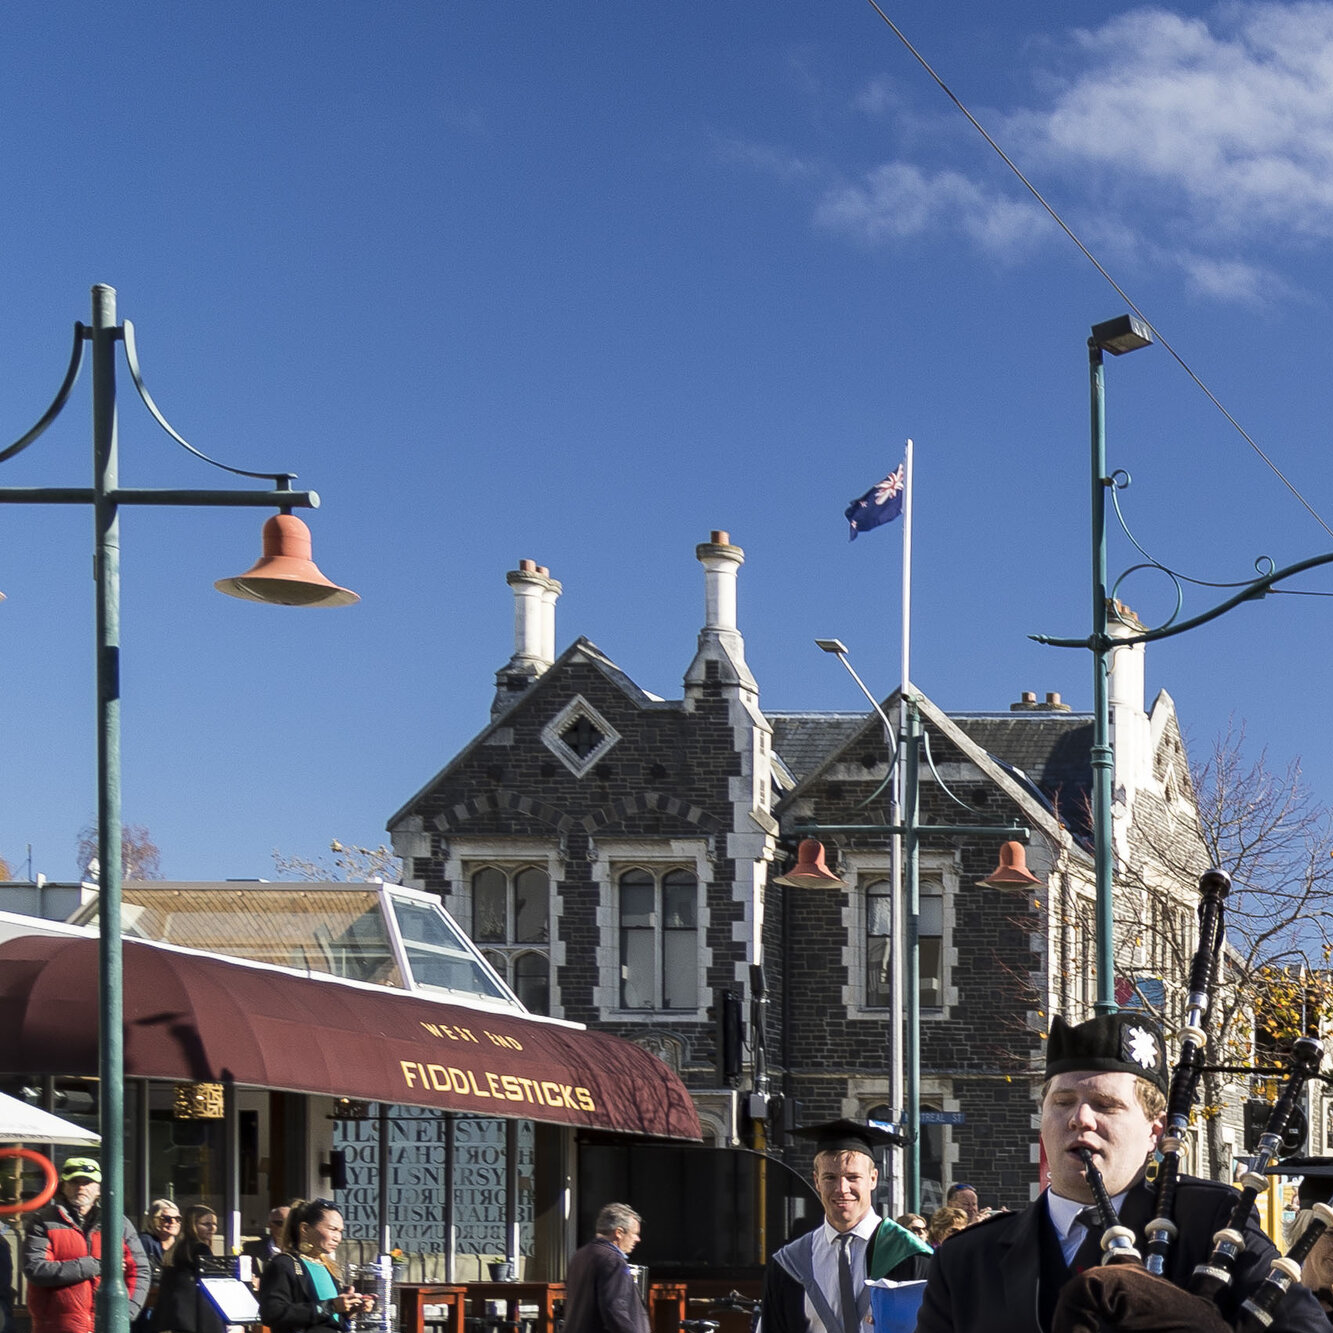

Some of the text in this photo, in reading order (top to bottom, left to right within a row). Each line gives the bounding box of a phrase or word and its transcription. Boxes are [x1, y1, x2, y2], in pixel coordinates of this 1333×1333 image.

[420, 1021, 524, 1051] WEST END
[400, 1060, 596, 1112] FIDDLESTICKS
